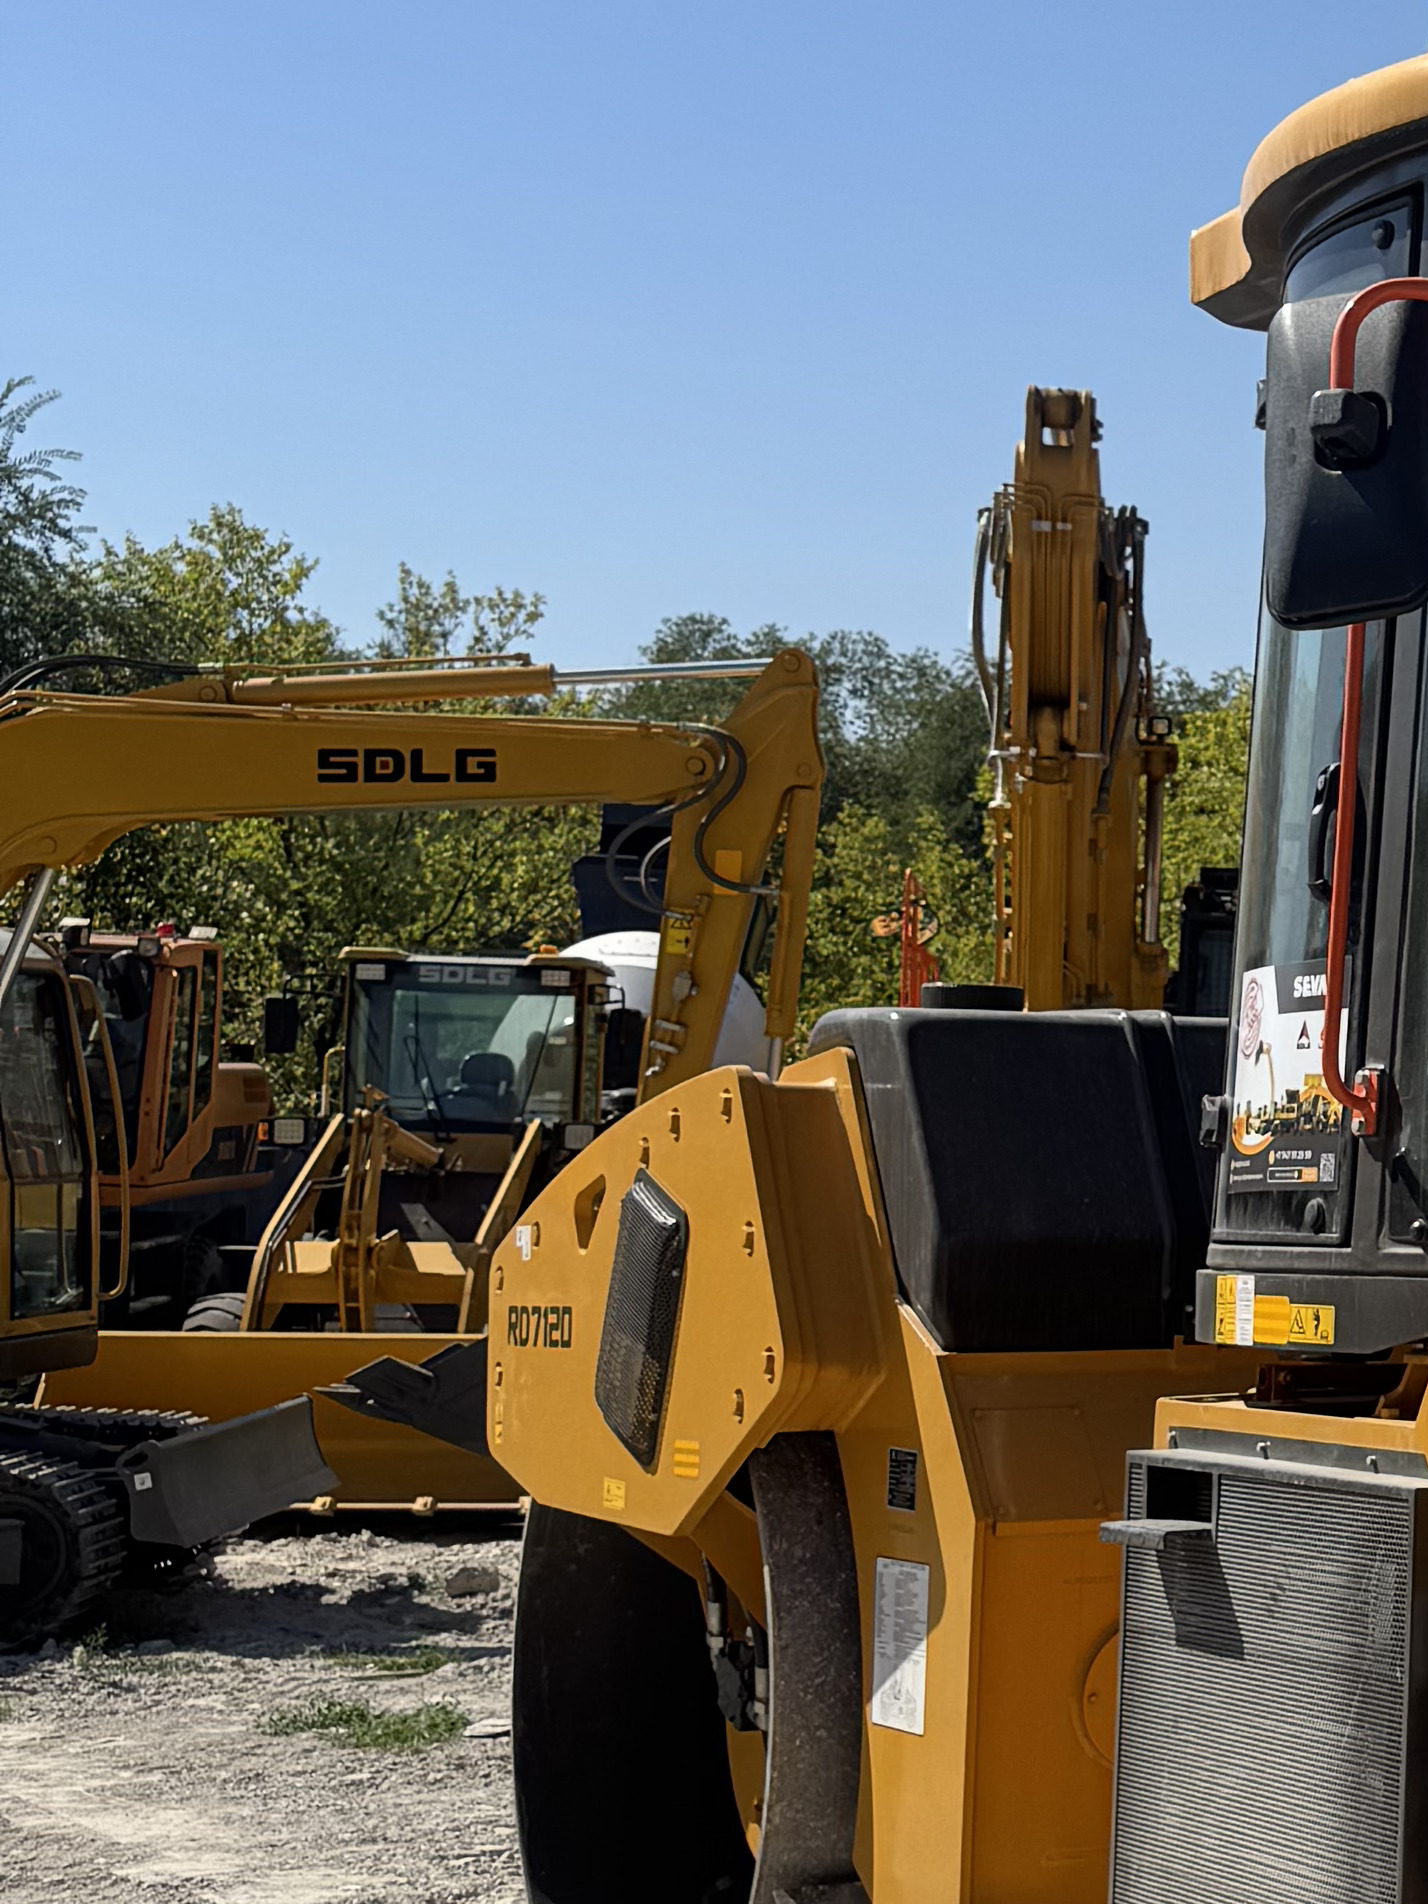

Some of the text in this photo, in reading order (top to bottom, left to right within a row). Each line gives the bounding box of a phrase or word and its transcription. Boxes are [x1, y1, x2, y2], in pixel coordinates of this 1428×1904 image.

[317, 748, 497, 783] SDLG
[418, 964, 511, 987] SDLG
[507, 1305, 573, 1349] RD7120
